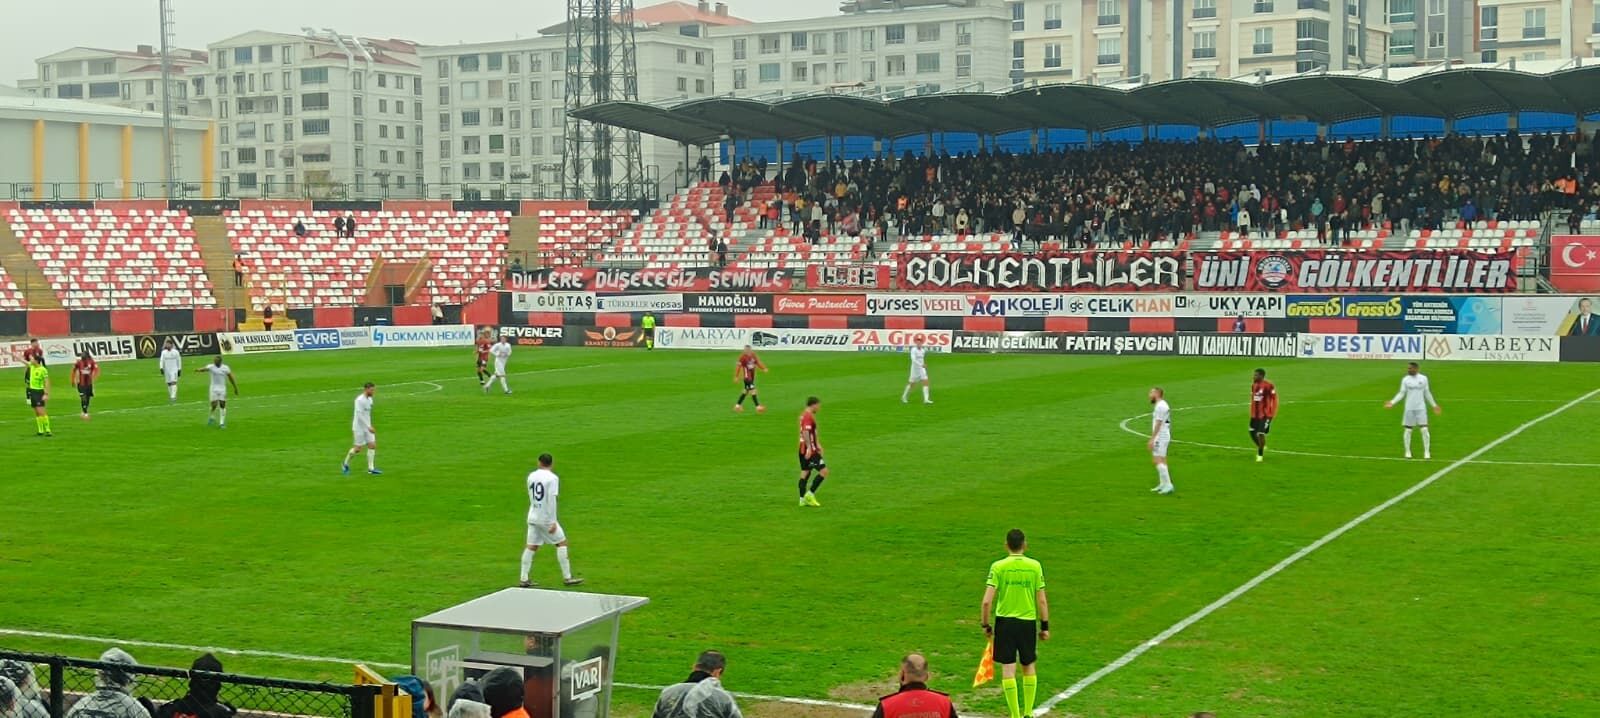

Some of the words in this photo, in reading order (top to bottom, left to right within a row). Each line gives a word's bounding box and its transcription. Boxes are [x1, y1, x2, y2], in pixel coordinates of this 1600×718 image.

[1200, 254, 1250, 287] ÜNİ
[1298, 254, 1508, 288] GÖLKENTLİLER
[512, 270, 584, 289] DİLLERE
[596, 268, 697, 291] DÜŞECEĞİZ
[709, 269, 785, 289] SENİNLE
[538, 293, 593, 309] GÜRTAŞ
[698, 293, 757, 307] HANOĞLU
[778, 298, 806, 311] Güven
[808, 298, 861, 311] Pastaneleri
[924, 299, 964, 311] VESTEL
[1008, 294, 1064, 311] KOLEJİ
[1209, 297, 1241, 310] UKY
[1246, 297, 1282, 310] YAPI
[385, 332, 434, 341] LOKMAN
[500, 326, 562, 338] SEVENLER
[680, 328, 746, 339] MARYAP
[792, 334, 849, 345] VANGÖLÜ
[852, 330, 880, 345] 2A
[888, 330, 950, 346] Gross
[954, 336, 999, 348] AZELİN
[1001, 336, 1058, 349] GELİNLİK
[1066, 335, 1111, 350] FATİH
[1114, 335, 1174, 355] ŞEVGİN
[1179, 335, 1200, 355] VAN
[1202, 336, 1252, 356] KAHVALTI
[1255, 332, 1297, 356] KONAĞI
[1324, 336, 1374, 353] BEST
[1381, 336, 1421, 353] VAN
[1458, 337, 1553, 352] MABEYN
[529, 481, 545, 501] 19
[574, 665, 599, 689] VAR
